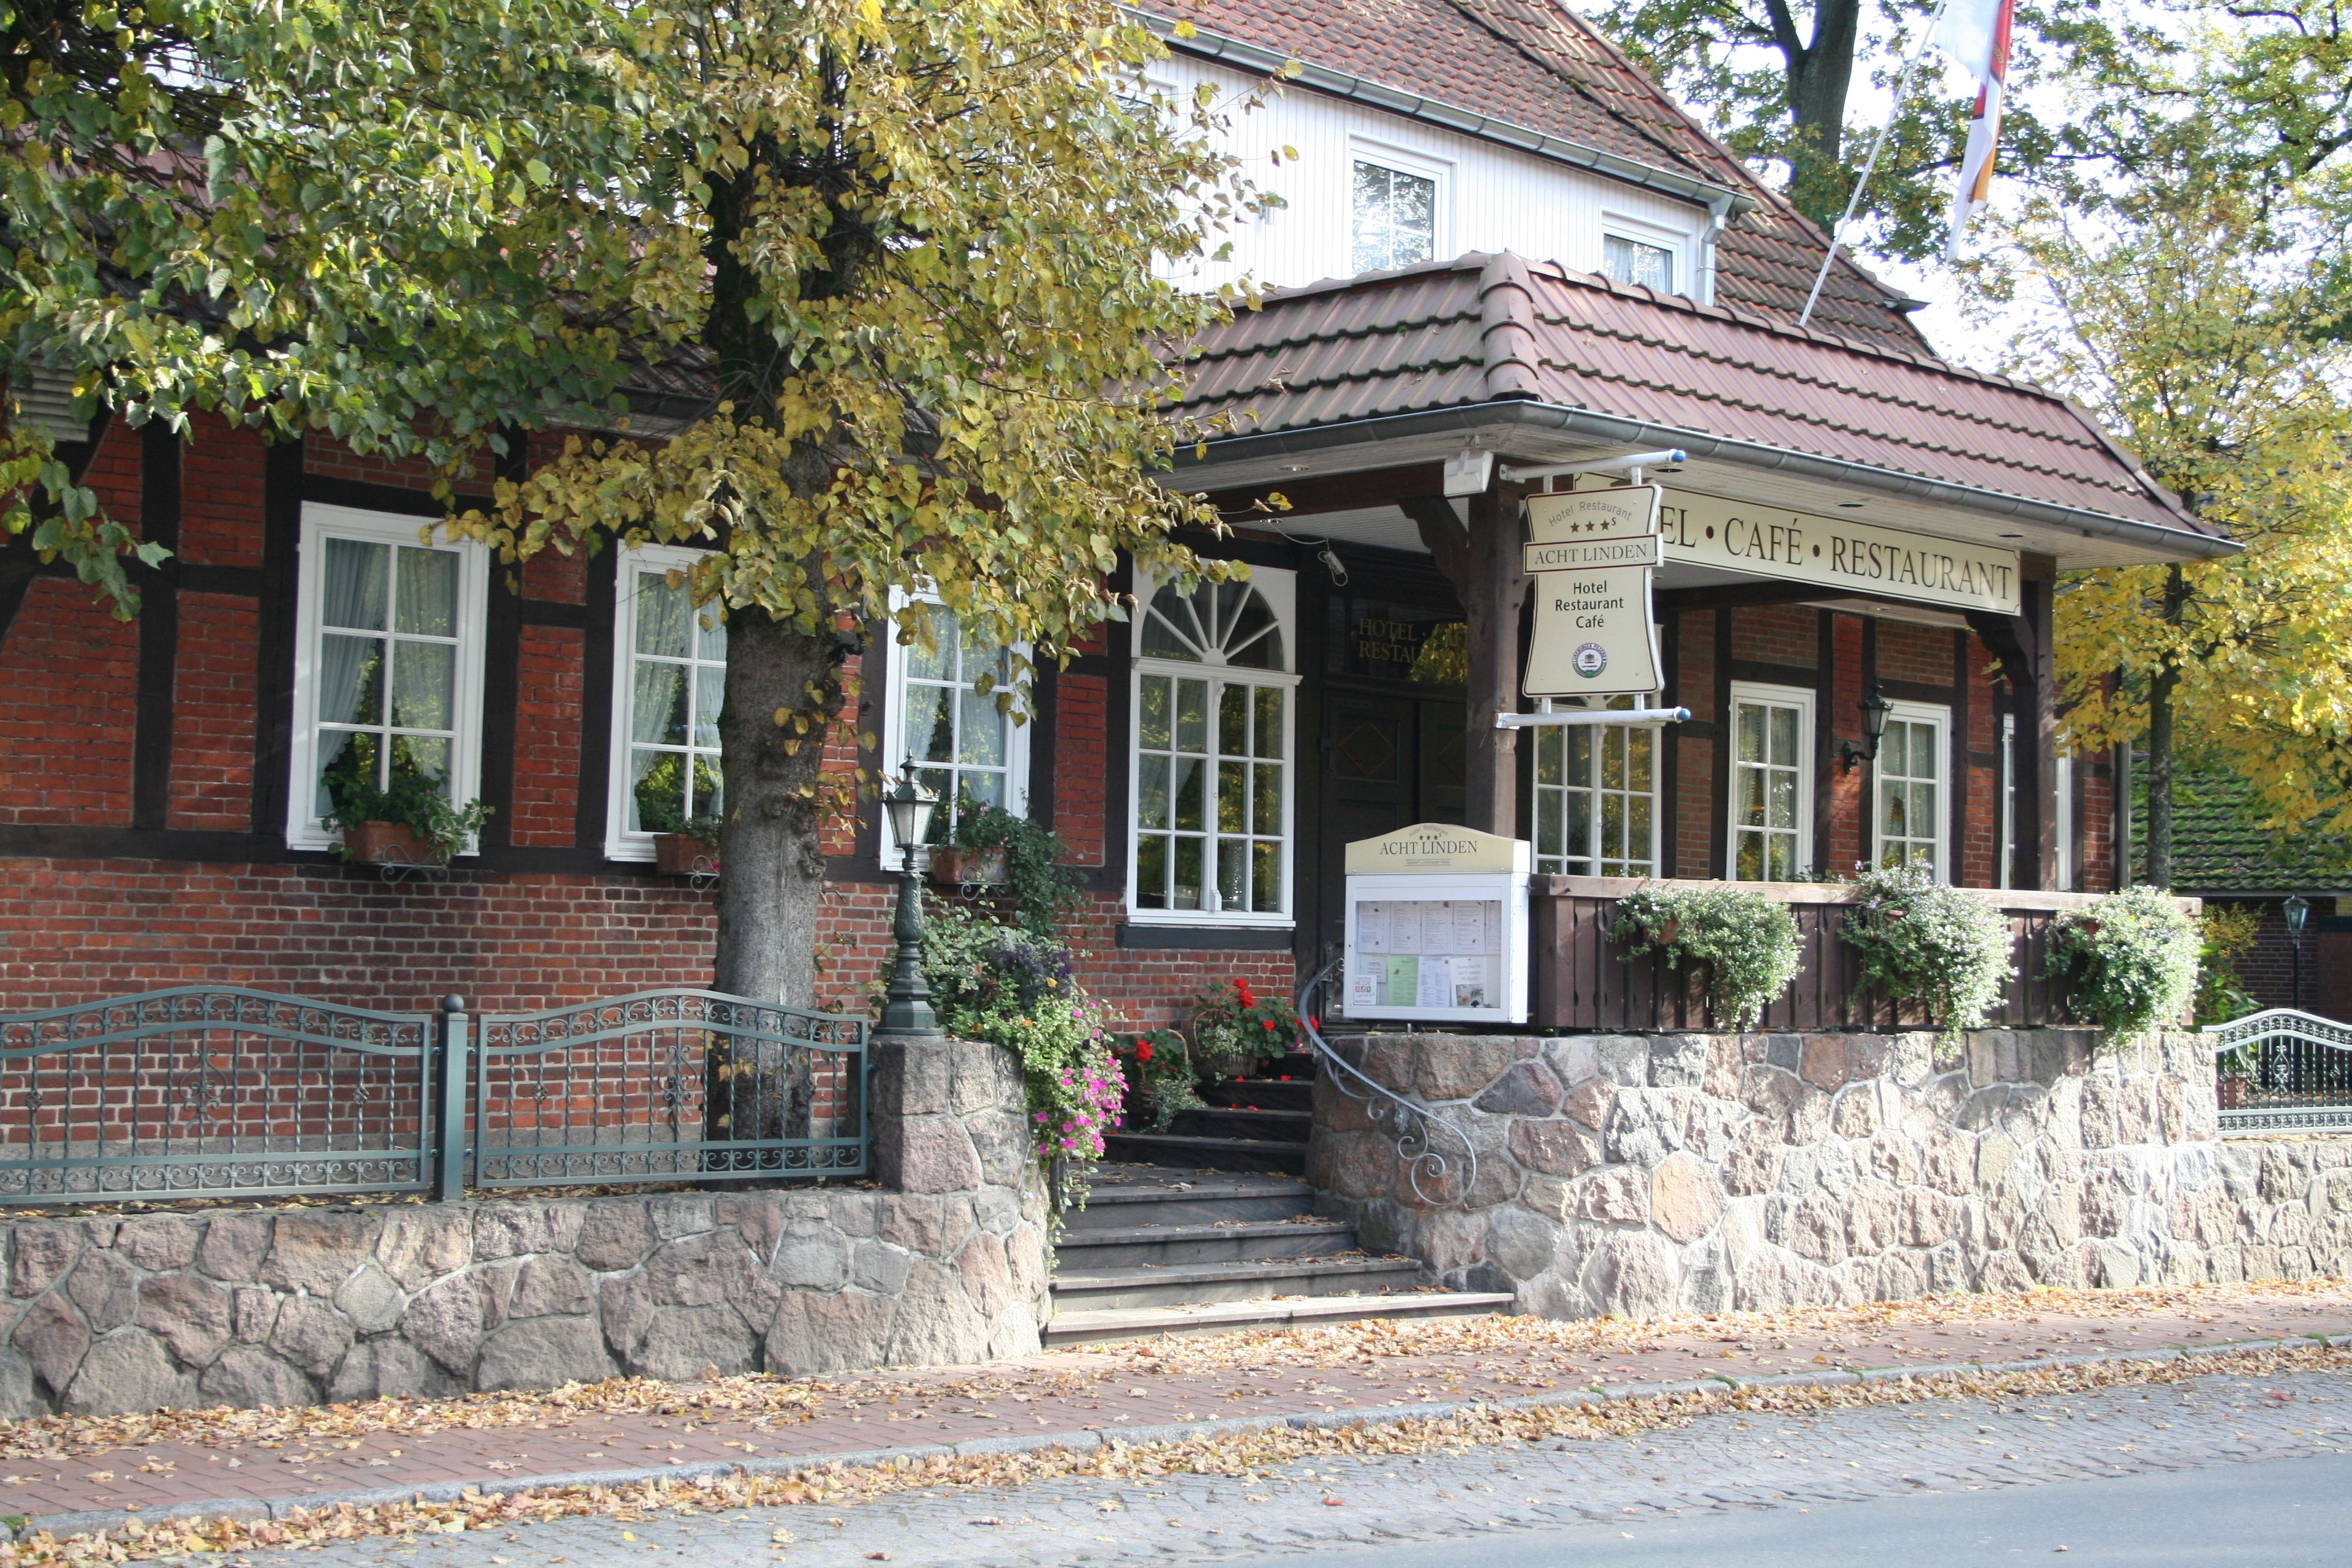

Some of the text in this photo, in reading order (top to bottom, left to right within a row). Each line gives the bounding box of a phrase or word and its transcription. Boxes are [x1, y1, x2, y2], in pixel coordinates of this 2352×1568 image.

[1548, 500, 1632, 526] Hotel Restaurant
[1535, 544, 1646, 565] ACHT LINDEN
[1660, 505, 2011, 600] EL CAFÉ RESTAURANT
[1574, 580, 1607, 594] Hotel
[1555, 597, 1624, 611] Restaurant
[1359, 618, 1417, 641] HOTEL
[1576, 614, 1604, 628] Café
[1380, 840, 1477, 855] ACHT LINDEN
